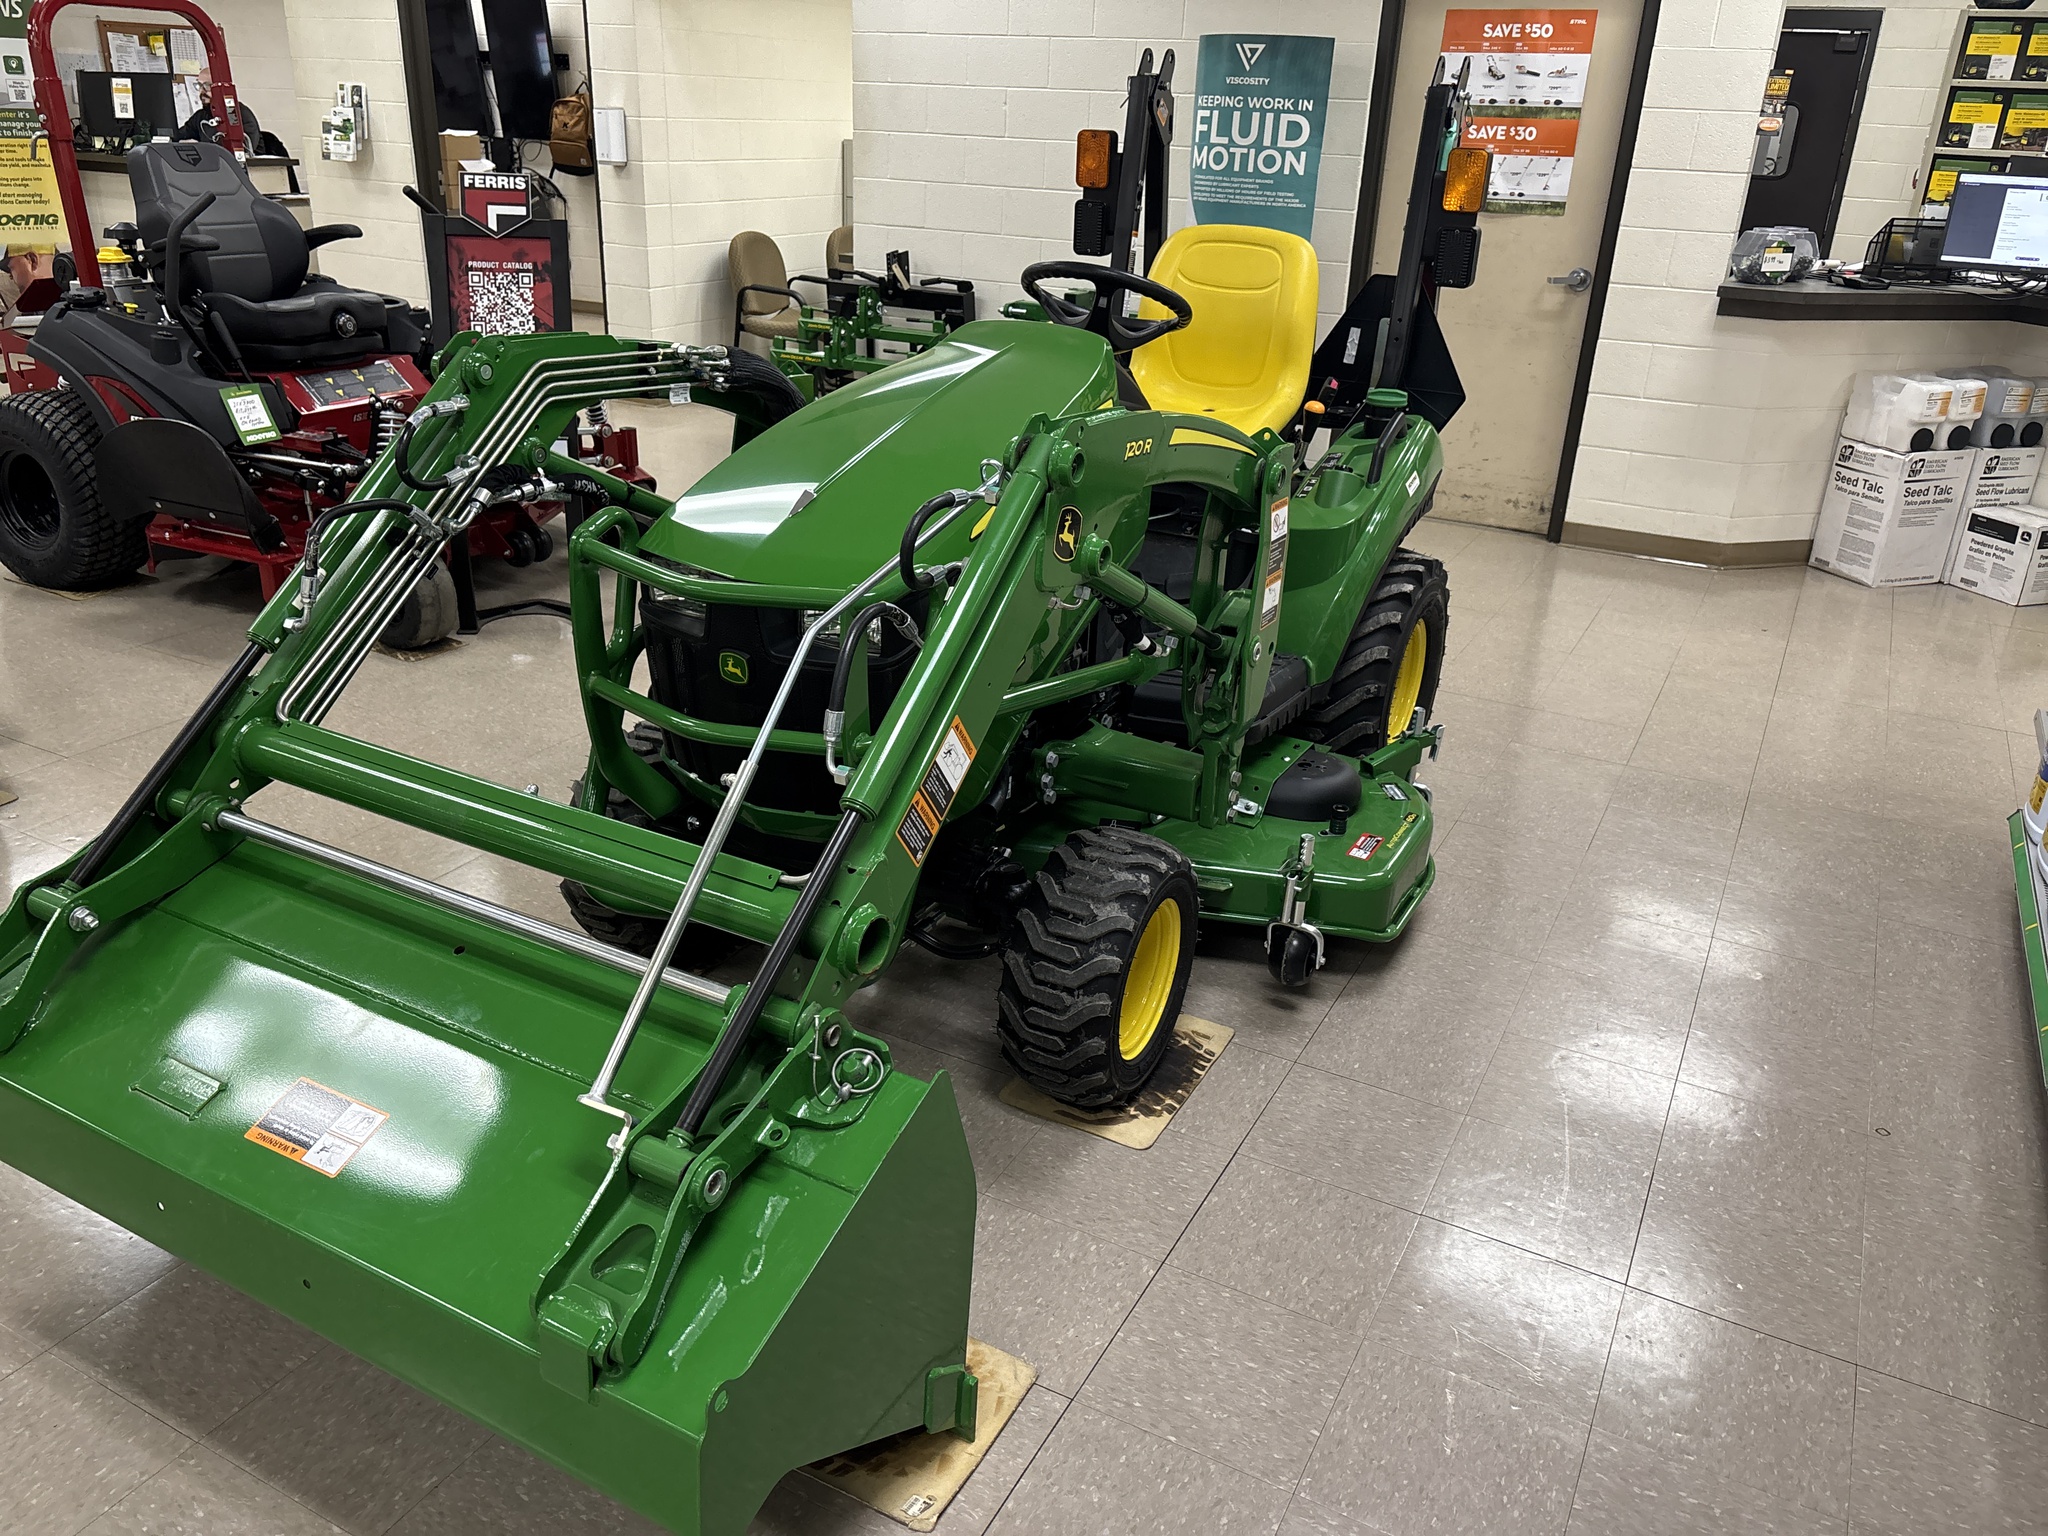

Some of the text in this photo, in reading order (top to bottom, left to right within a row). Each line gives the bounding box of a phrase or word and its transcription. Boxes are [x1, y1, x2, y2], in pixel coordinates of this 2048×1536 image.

[1482, 23, 1554, 38] SAVE $50
[1225, 76, 1271, 86] VISCOSITY
[1198, 95, 1314, 112] KEEPING WORK IN
[1195, 110, 1311, 148] FLUID
[1468, 124, 1538, 141] SAVE $30
[1192, 145, 1307, 176] MOTION
[464, 174, 527, 190] FERRIS
[468, 260, 500, 268] PRODUCT
[1834, 470, 1884, 494] Seed Talc
[1834, 484, 1848, 494] Talco
[1860, 492, 1884, 504] Semillas
[1904, 484, 1954, 498] Seed Talc
[1975, 486, 2030, 496] Seed Flow Lubricant
[1968, 546, 1985, 556] Grafito
[1992, 552, 2006, 562] Polvo
[1970, 538, 2014, 556] Powdered Graphite
[958, 730, 974, 756] WARNING
[920, 803, 936, 831] WARNING
[256, 1132, 290, 1153] WARNING
